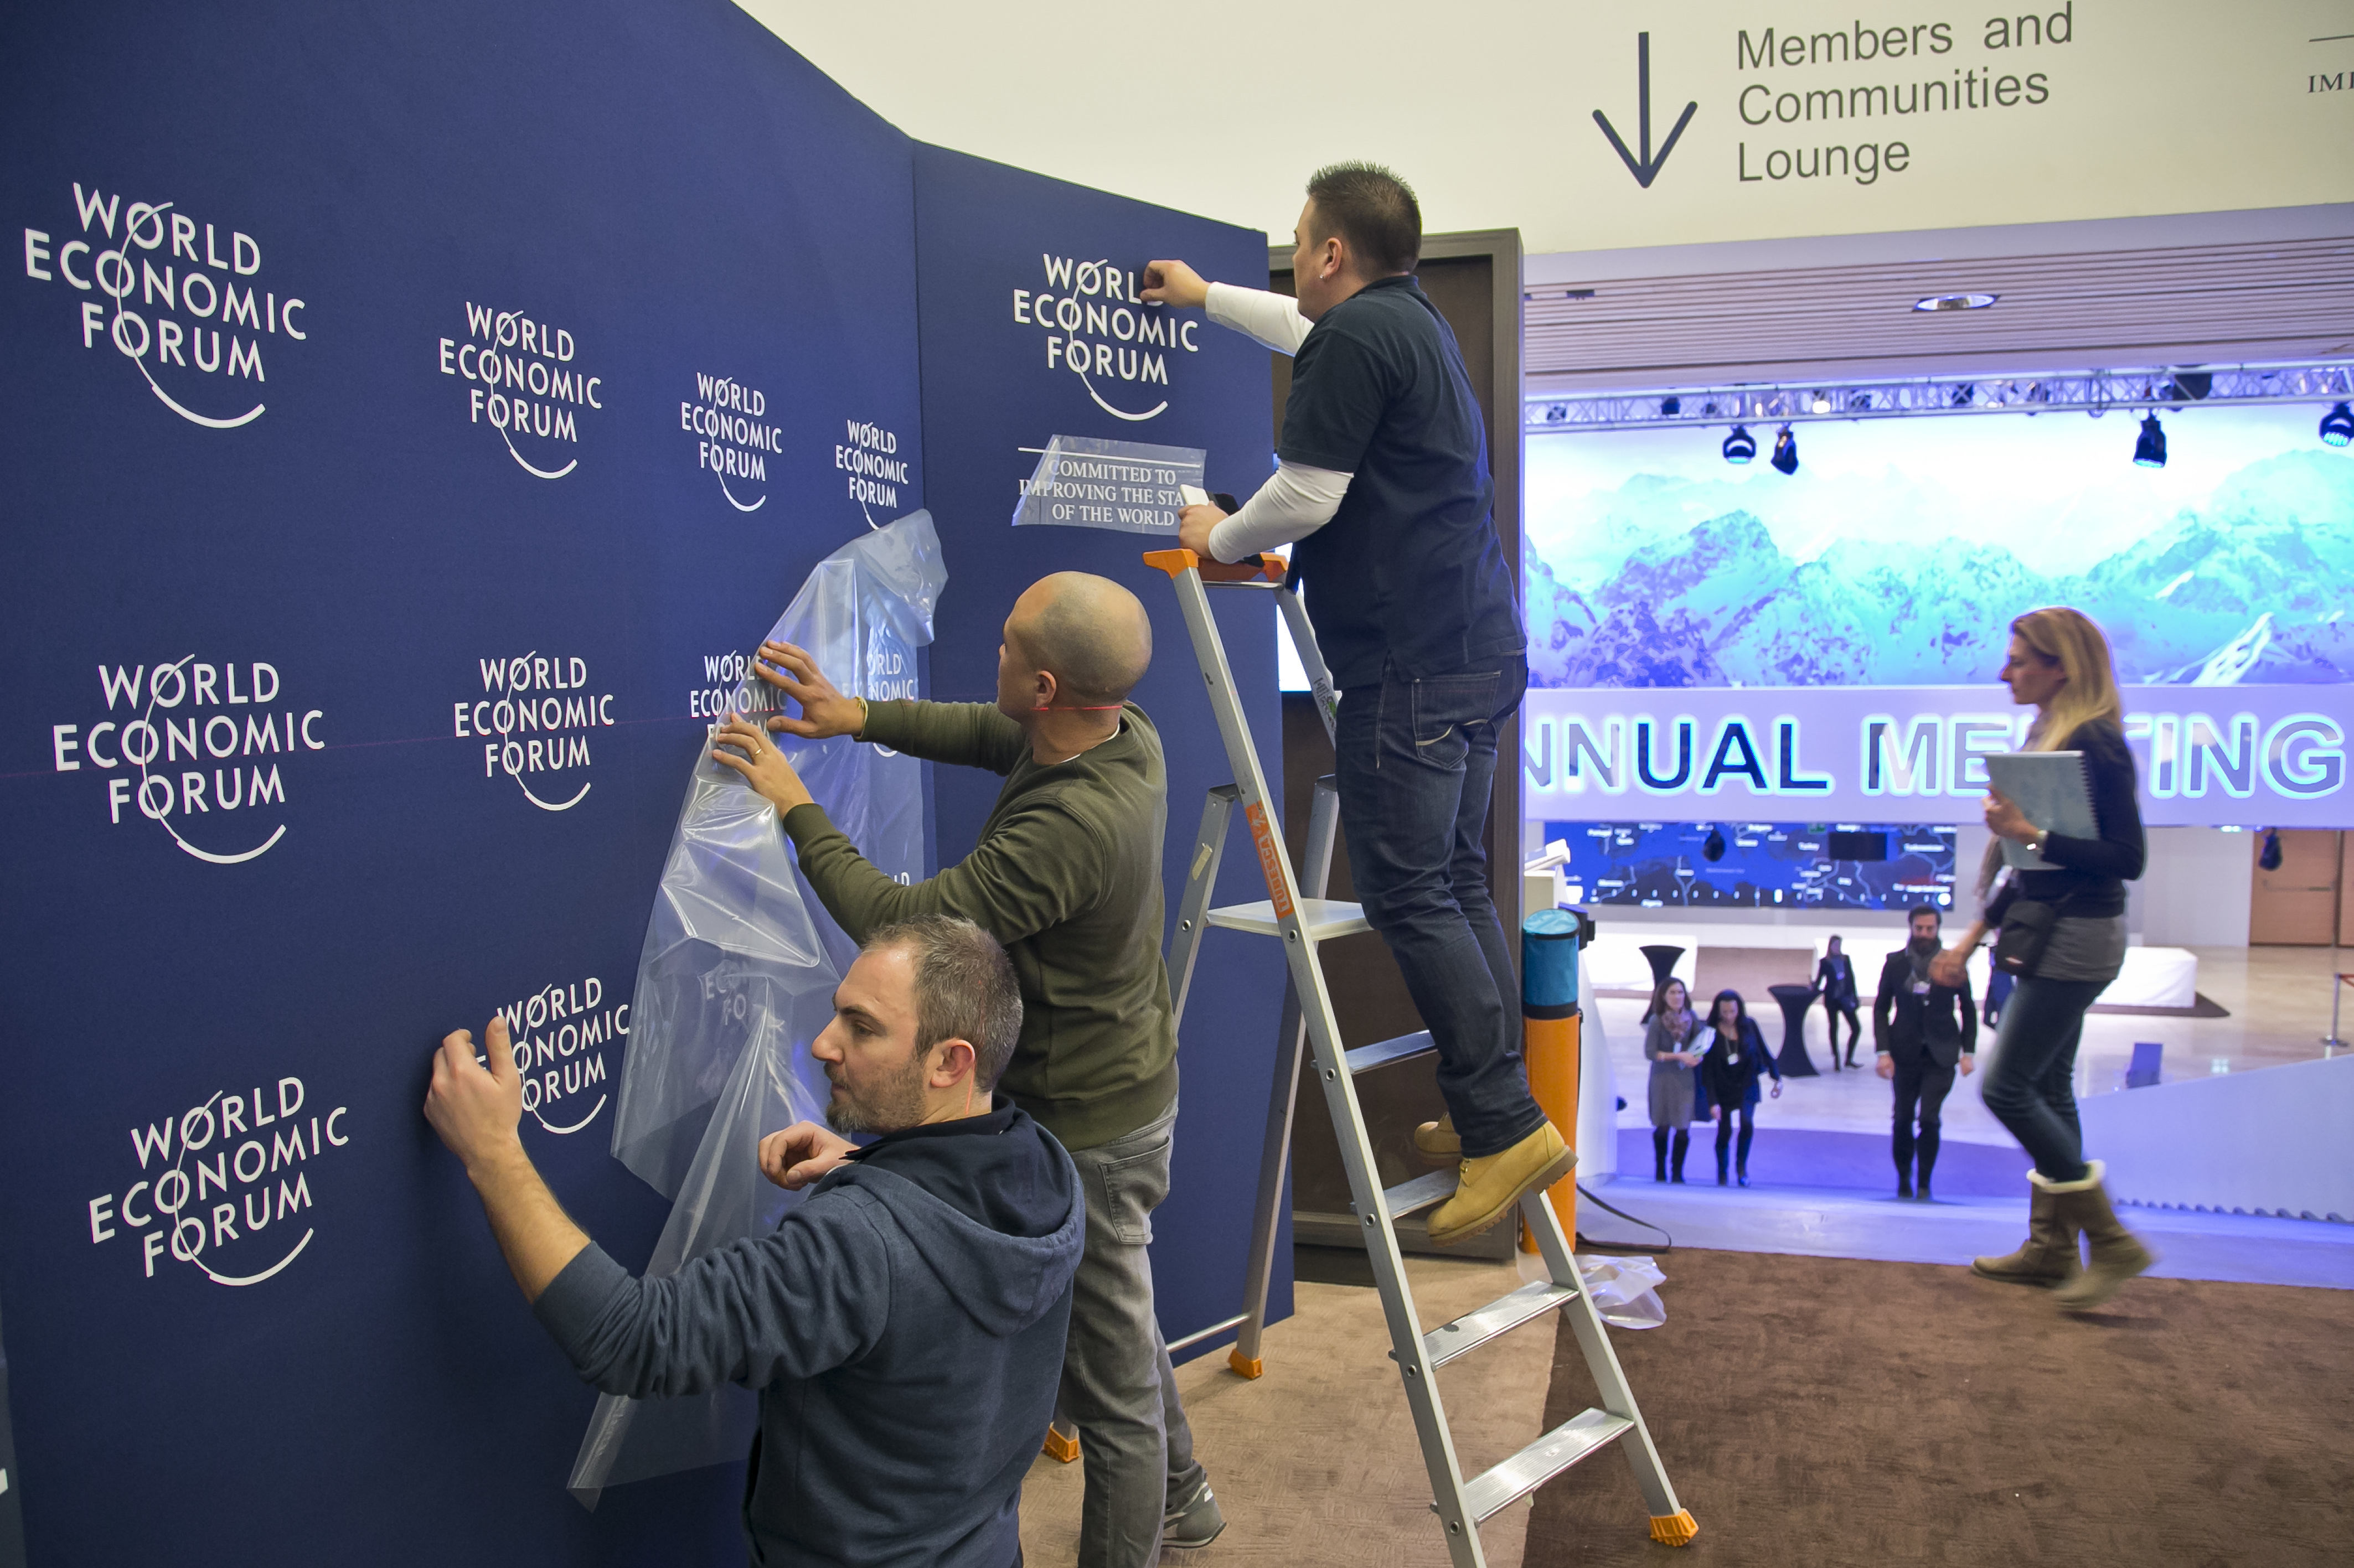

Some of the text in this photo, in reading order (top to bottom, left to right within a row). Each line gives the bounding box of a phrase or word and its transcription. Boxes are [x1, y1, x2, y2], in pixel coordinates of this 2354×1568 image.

[1738, 0, 2072, 70] Members and
[1739, 66, 2050, 125] Communities
[1739, 141, 1910, 185] Lounge
[73, 182, 261, 276] WORLD
[24, 228, 307, 340] ECONOMIC
[1043, 253, 1164, 307] WORL
[81, 301, 266, 382] FORUM
[466, 301, 575, 361] WORLD
[1014, 288, 1199, 352] ECONOMIC
[440, 337, 602, 409] ECONOMIC
[1047, 335, 1168, 385] FORUM
[470, 388, 577, 443] FORUM
[696, 371, 766, 417] WORLD
[681, 401, 783, 454] ECONOMIC
[846, 419, 897, 454] WORLD
[699, 441, 766, 482] FORUM
[835, 444, 909, 485] ECONOMIC
[1048, 460, 1176, 485] COMMITTED TO
[849, 476, 897, 509] FORUM
[1019, 479, 1186, 506] IMPROVING THE STA
[1052, 503, 1175, 526] OF THE WORLD
[98, 662, 280, 711] WORLD
[479, 657, 587, 693] WORLD
[690, 687, 787, 718] ECONOMIC
[868, 679, 915, 702] NOMIC
[53, 709, 325, 772] ECONOMIC
[454, 694, 615, 737] ECONOMIC
[485, 734, 591, 778] FORUM
[1525, 716, 2344, 796] NNUAL MEING
[109, 763, 286, 824] FORUM
[1259, 836, 1289, 910] TUBESCA
[497, 977, 602, 1034] WORLD
[476, 1004, 631, 1074] ONOMIC
[522, 1051, 606, 1111] ORUM
[130, 1076, 304, 1170] WORLD
[89, 1106, 349, 1244] ECONOMIC
[143, 1171, 313, 1278] FORUM
